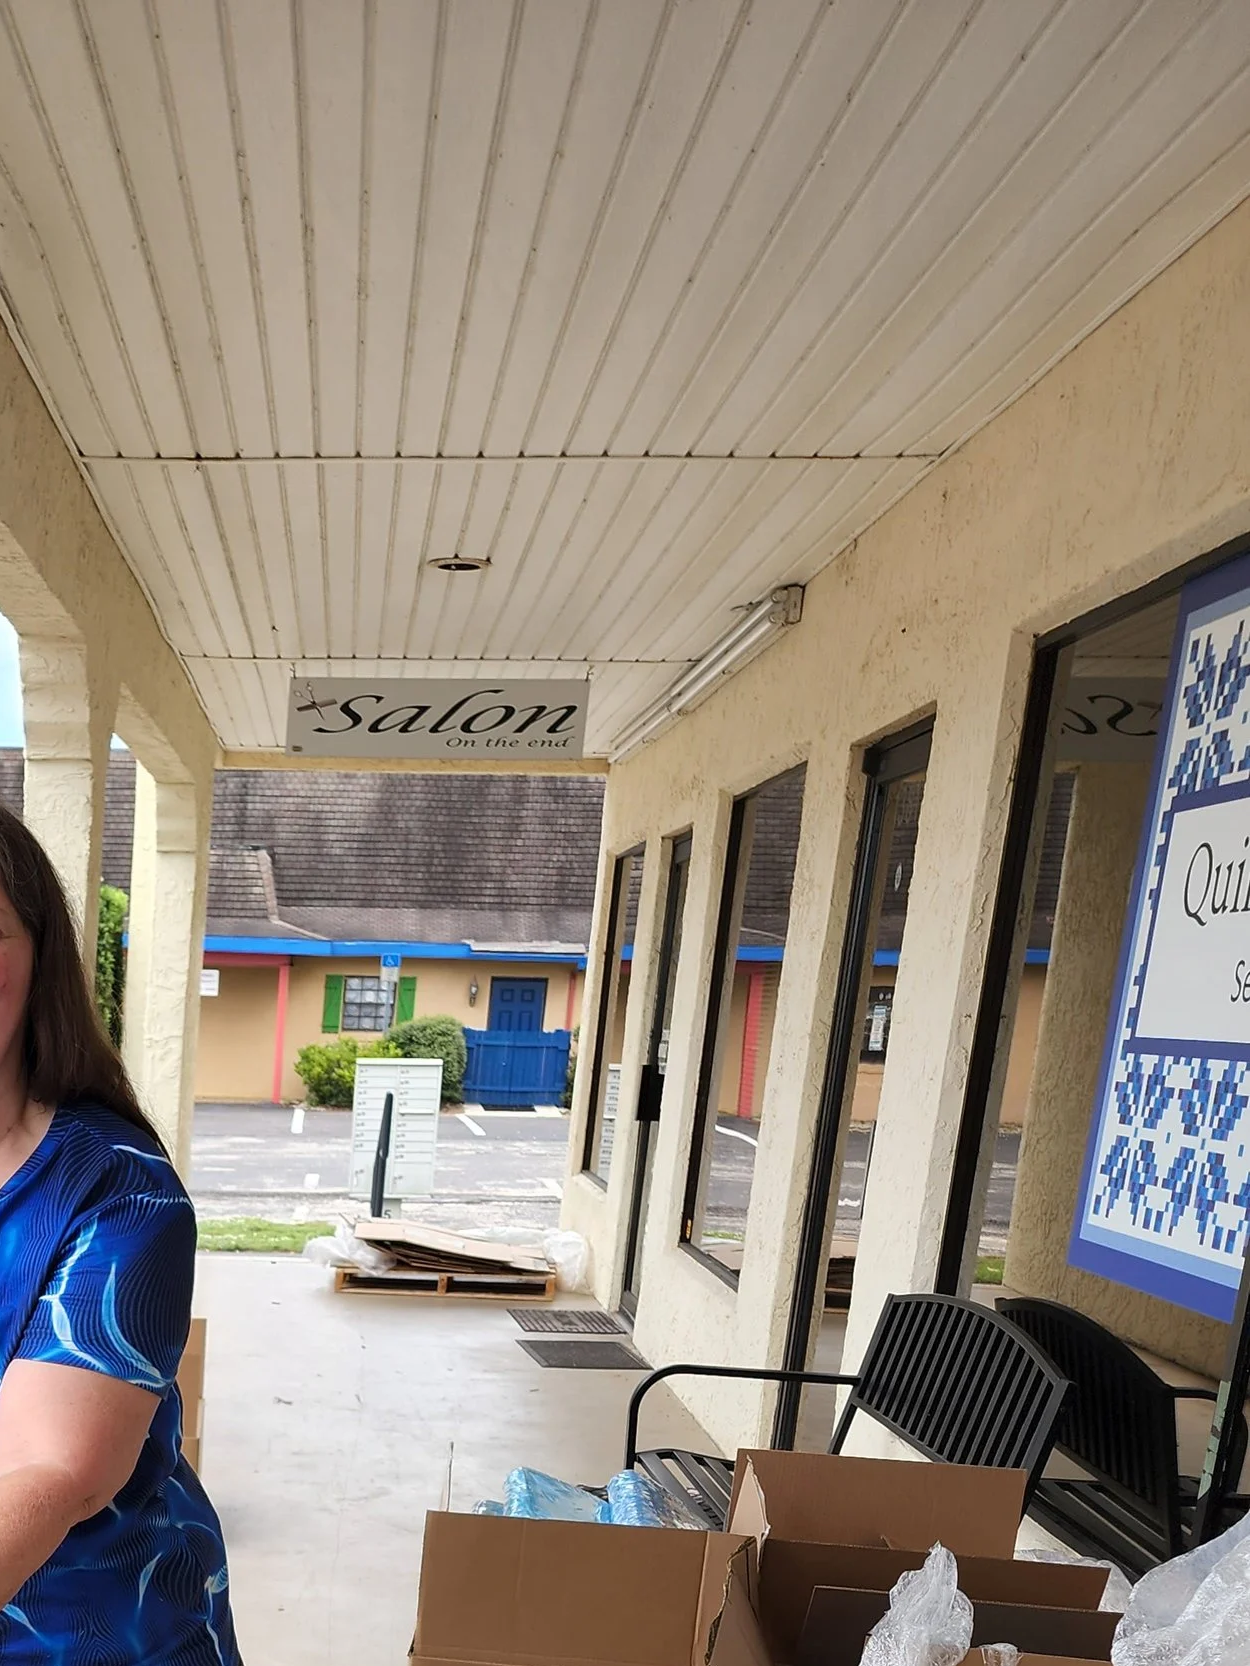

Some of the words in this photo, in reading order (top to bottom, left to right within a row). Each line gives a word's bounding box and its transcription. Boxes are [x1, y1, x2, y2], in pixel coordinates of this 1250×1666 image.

[313, 688, 579, 735] Salon
[446, 736, 475, 748] On
[485, 736, 519, 748] the
[527, 736, 573, 748] end
